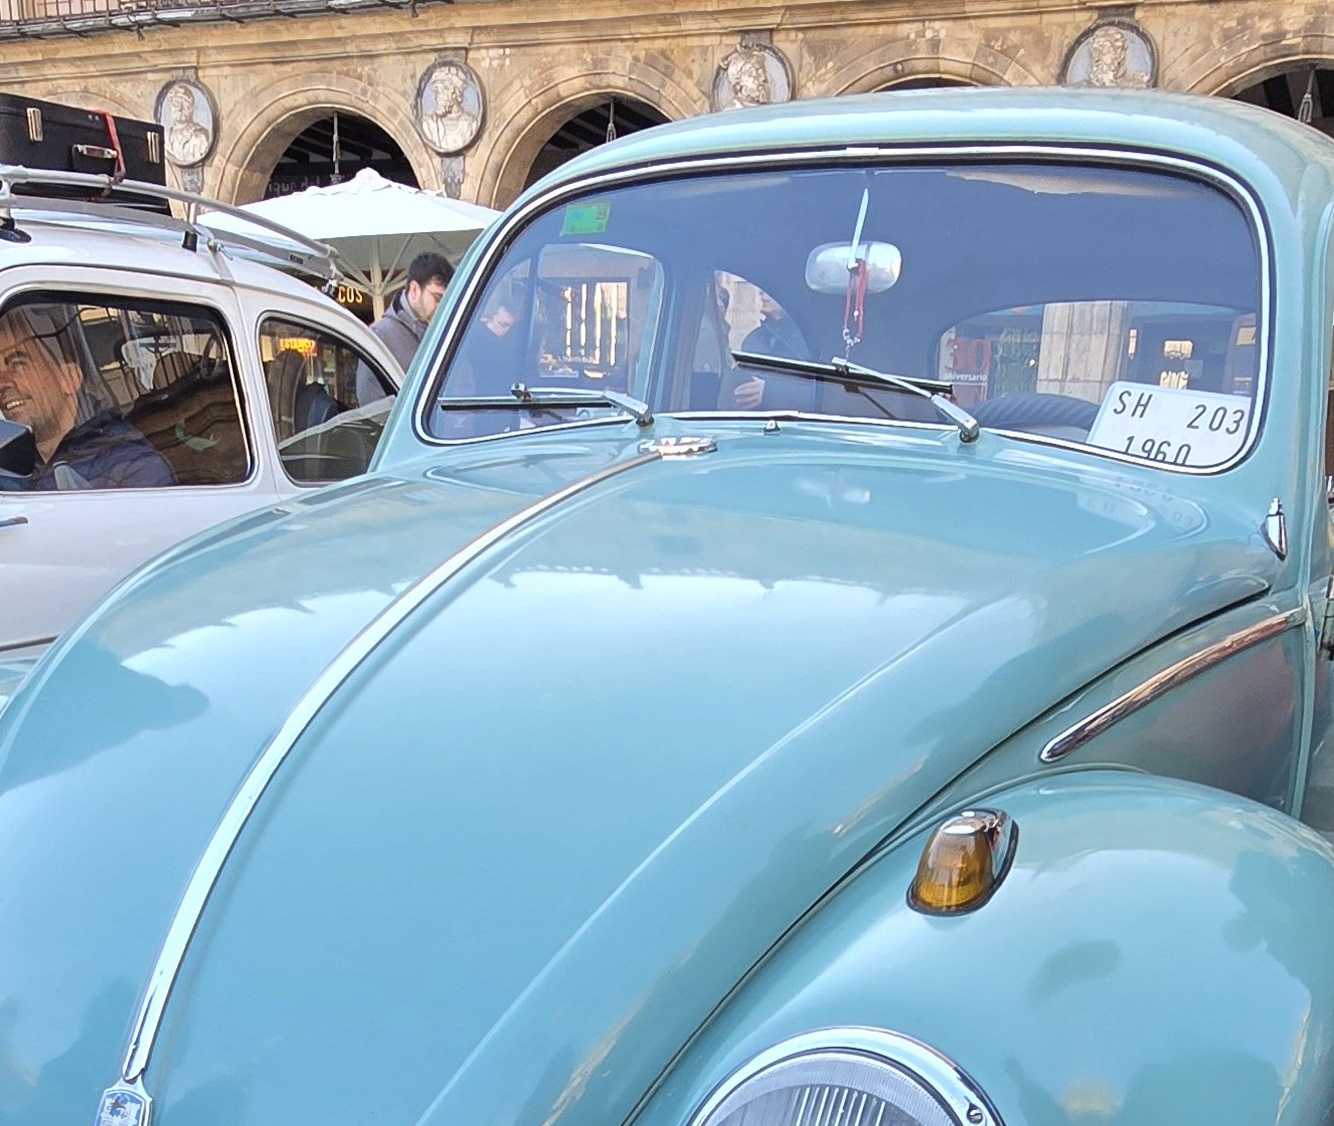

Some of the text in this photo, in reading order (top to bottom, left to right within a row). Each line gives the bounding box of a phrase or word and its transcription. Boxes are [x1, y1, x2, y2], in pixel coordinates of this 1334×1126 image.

[1113, 390, 1246, 436] SH 203
[1123, 435, 1192, 465] 1960
